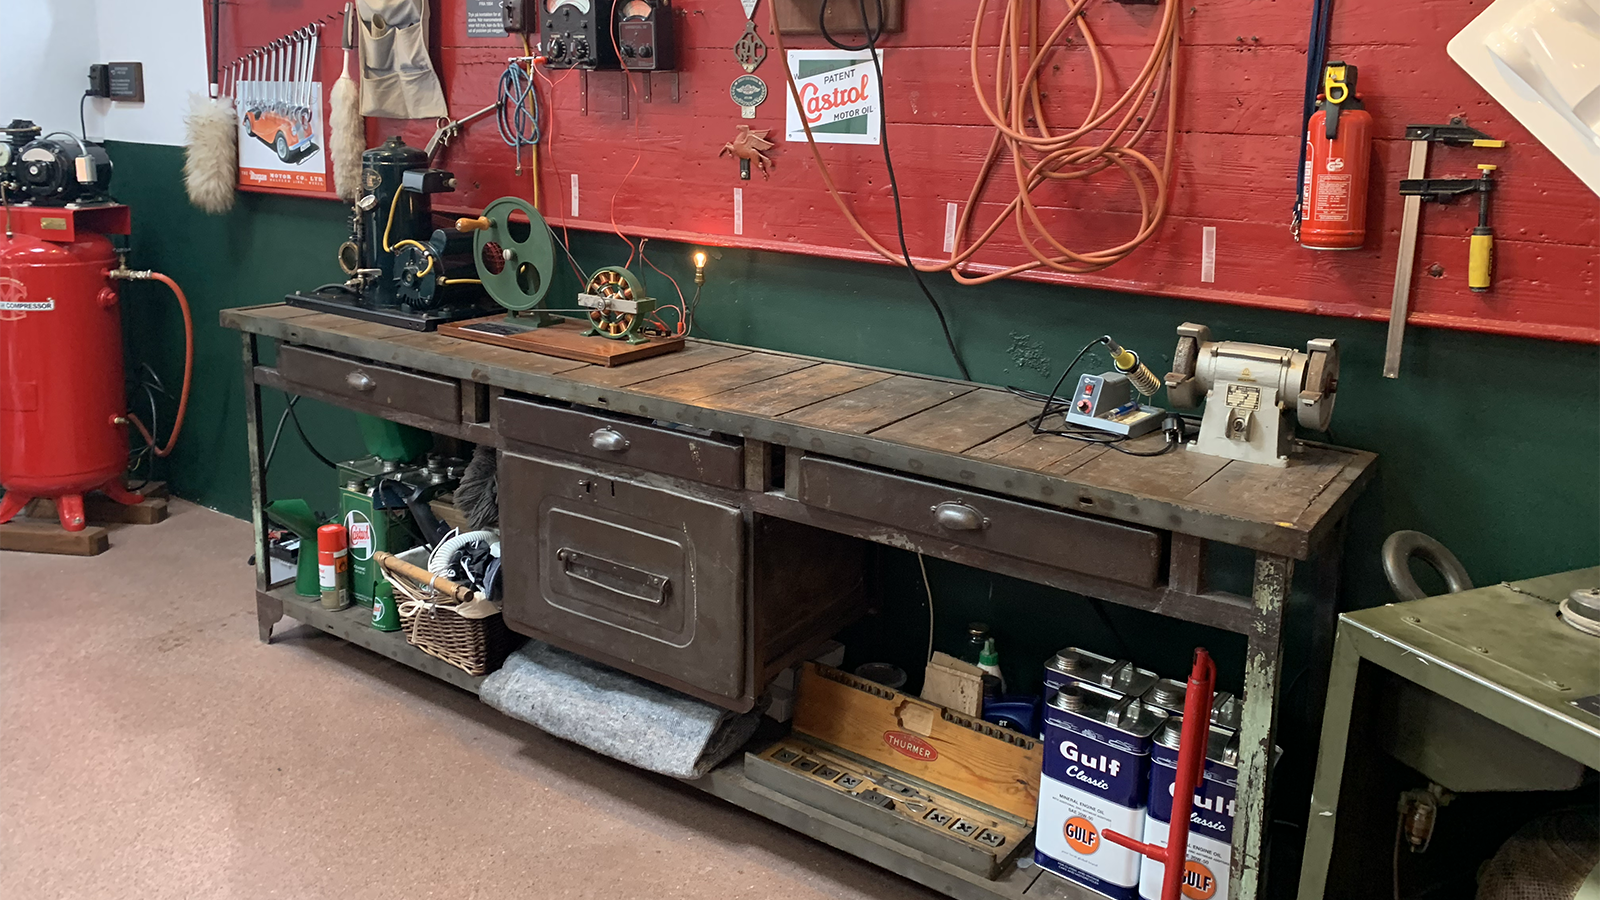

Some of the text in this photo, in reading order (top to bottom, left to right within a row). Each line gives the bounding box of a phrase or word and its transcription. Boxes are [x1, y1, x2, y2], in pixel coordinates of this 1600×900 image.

[824, 69, 856, 84] PATENT
[800, 74, 869, 123] Castrol
[833, 105, 874, 121] MOTOR OIL
[888, 735, 931, 758] THURMER
[1060, 740, 1121, 777] Gulf
[1066, 765, 1109, 790] Classic
[1059, 793, 1078, 805] MINERAL
[1079, 802, 1096, 811] ENGINE
[1190, 812, 1226, 832] lassic
[1066, 823, 1096, 846] GULF
[1193, 844, 1212, 854] ENGINE
